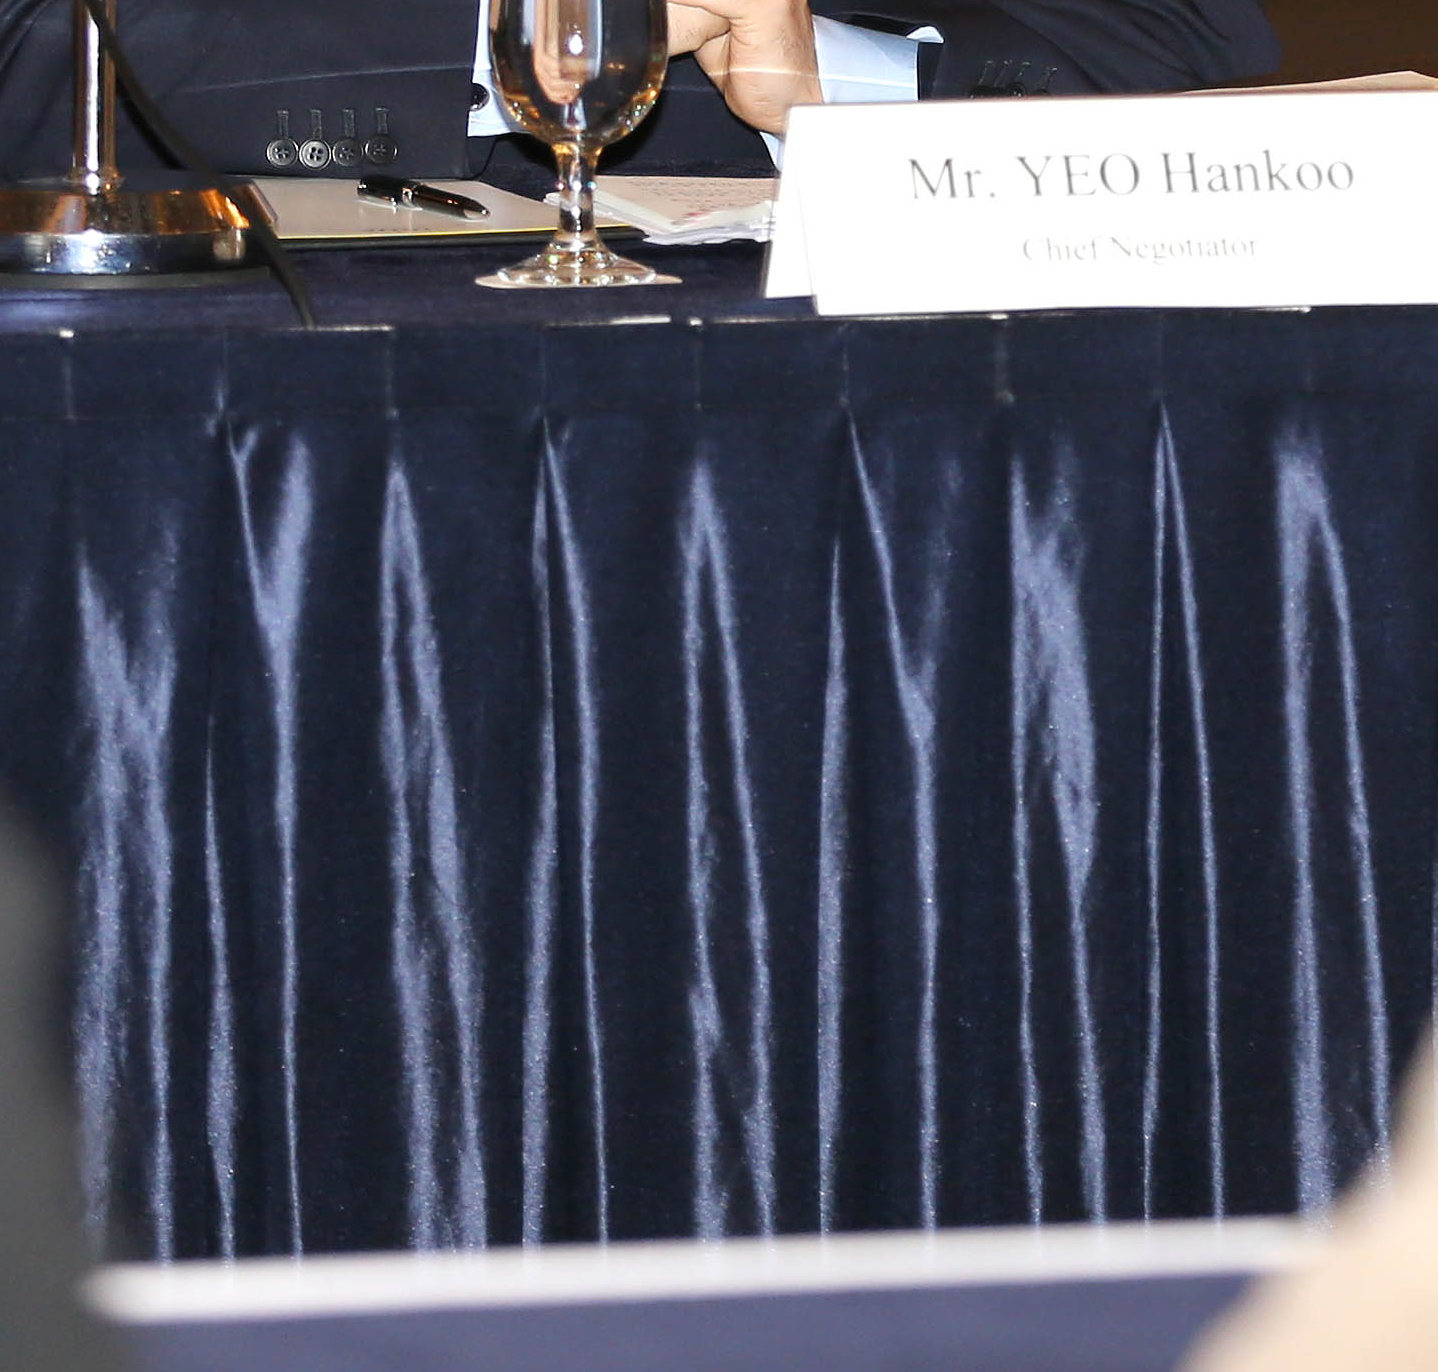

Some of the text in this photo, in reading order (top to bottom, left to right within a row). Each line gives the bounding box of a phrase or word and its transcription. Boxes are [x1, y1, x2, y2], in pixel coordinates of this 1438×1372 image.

[907, 148, 1355, 200] Mr. YEO Hankoo
[1022, 235, 1257, 266] Chief Negotiator
